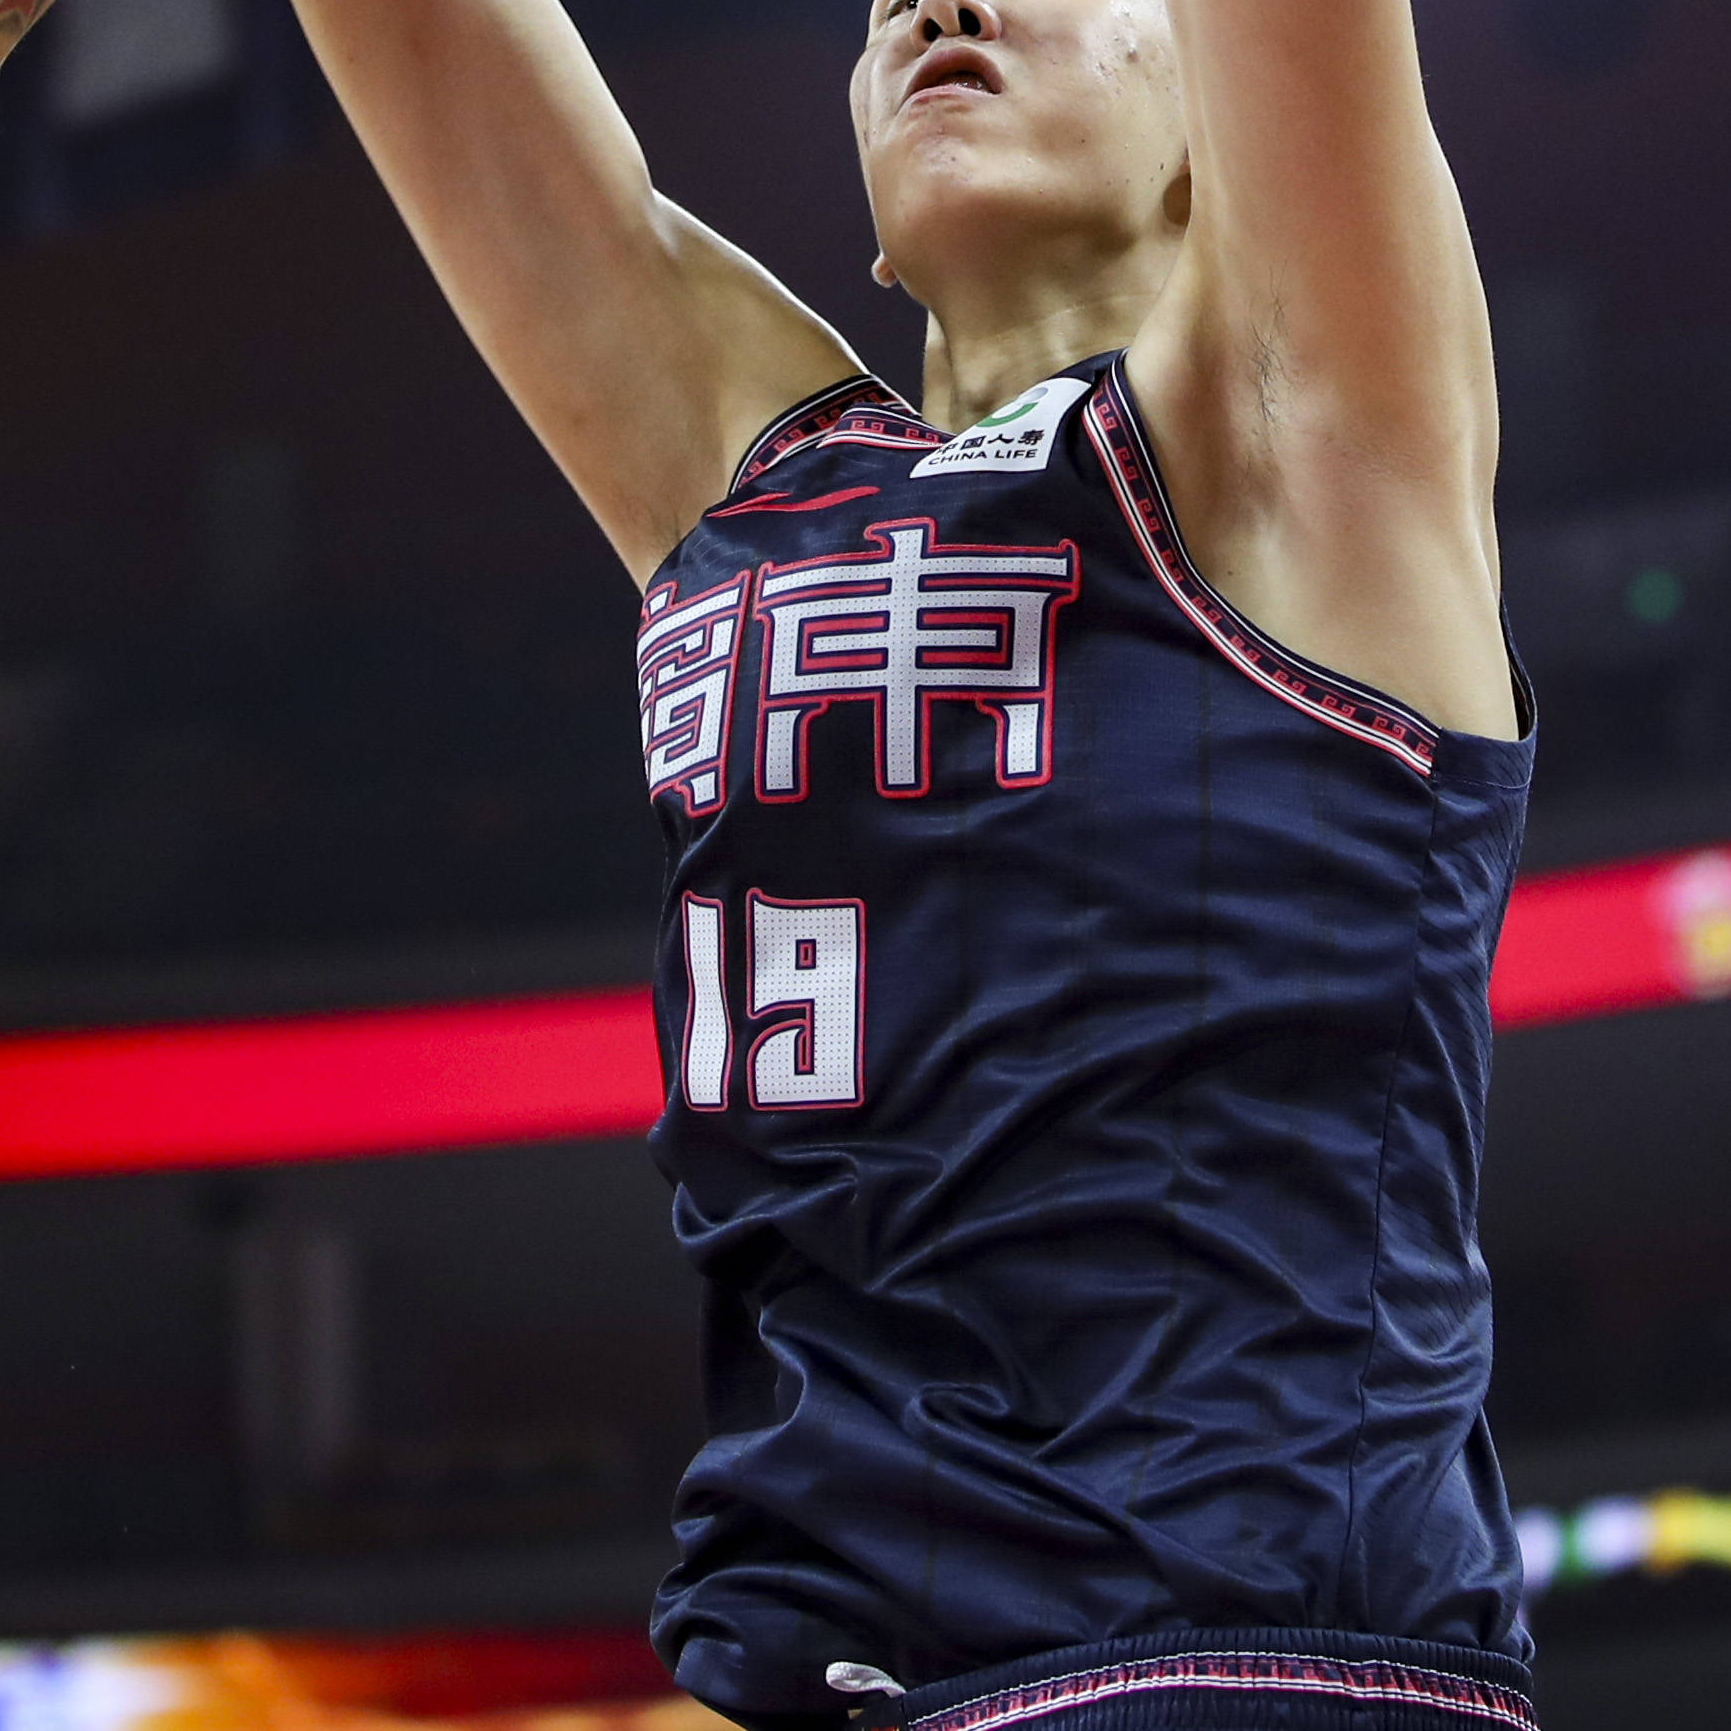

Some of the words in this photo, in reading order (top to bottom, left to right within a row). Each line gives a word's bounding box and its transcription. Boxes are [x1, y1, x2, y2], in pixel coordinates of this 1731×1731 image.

[936, 429, 1045, 454] 中国人寿
[928, 450, 987, 465] CHINA
[994, 449, 1037, 459] LIFE
[681, 889, 865, 1111] 19
